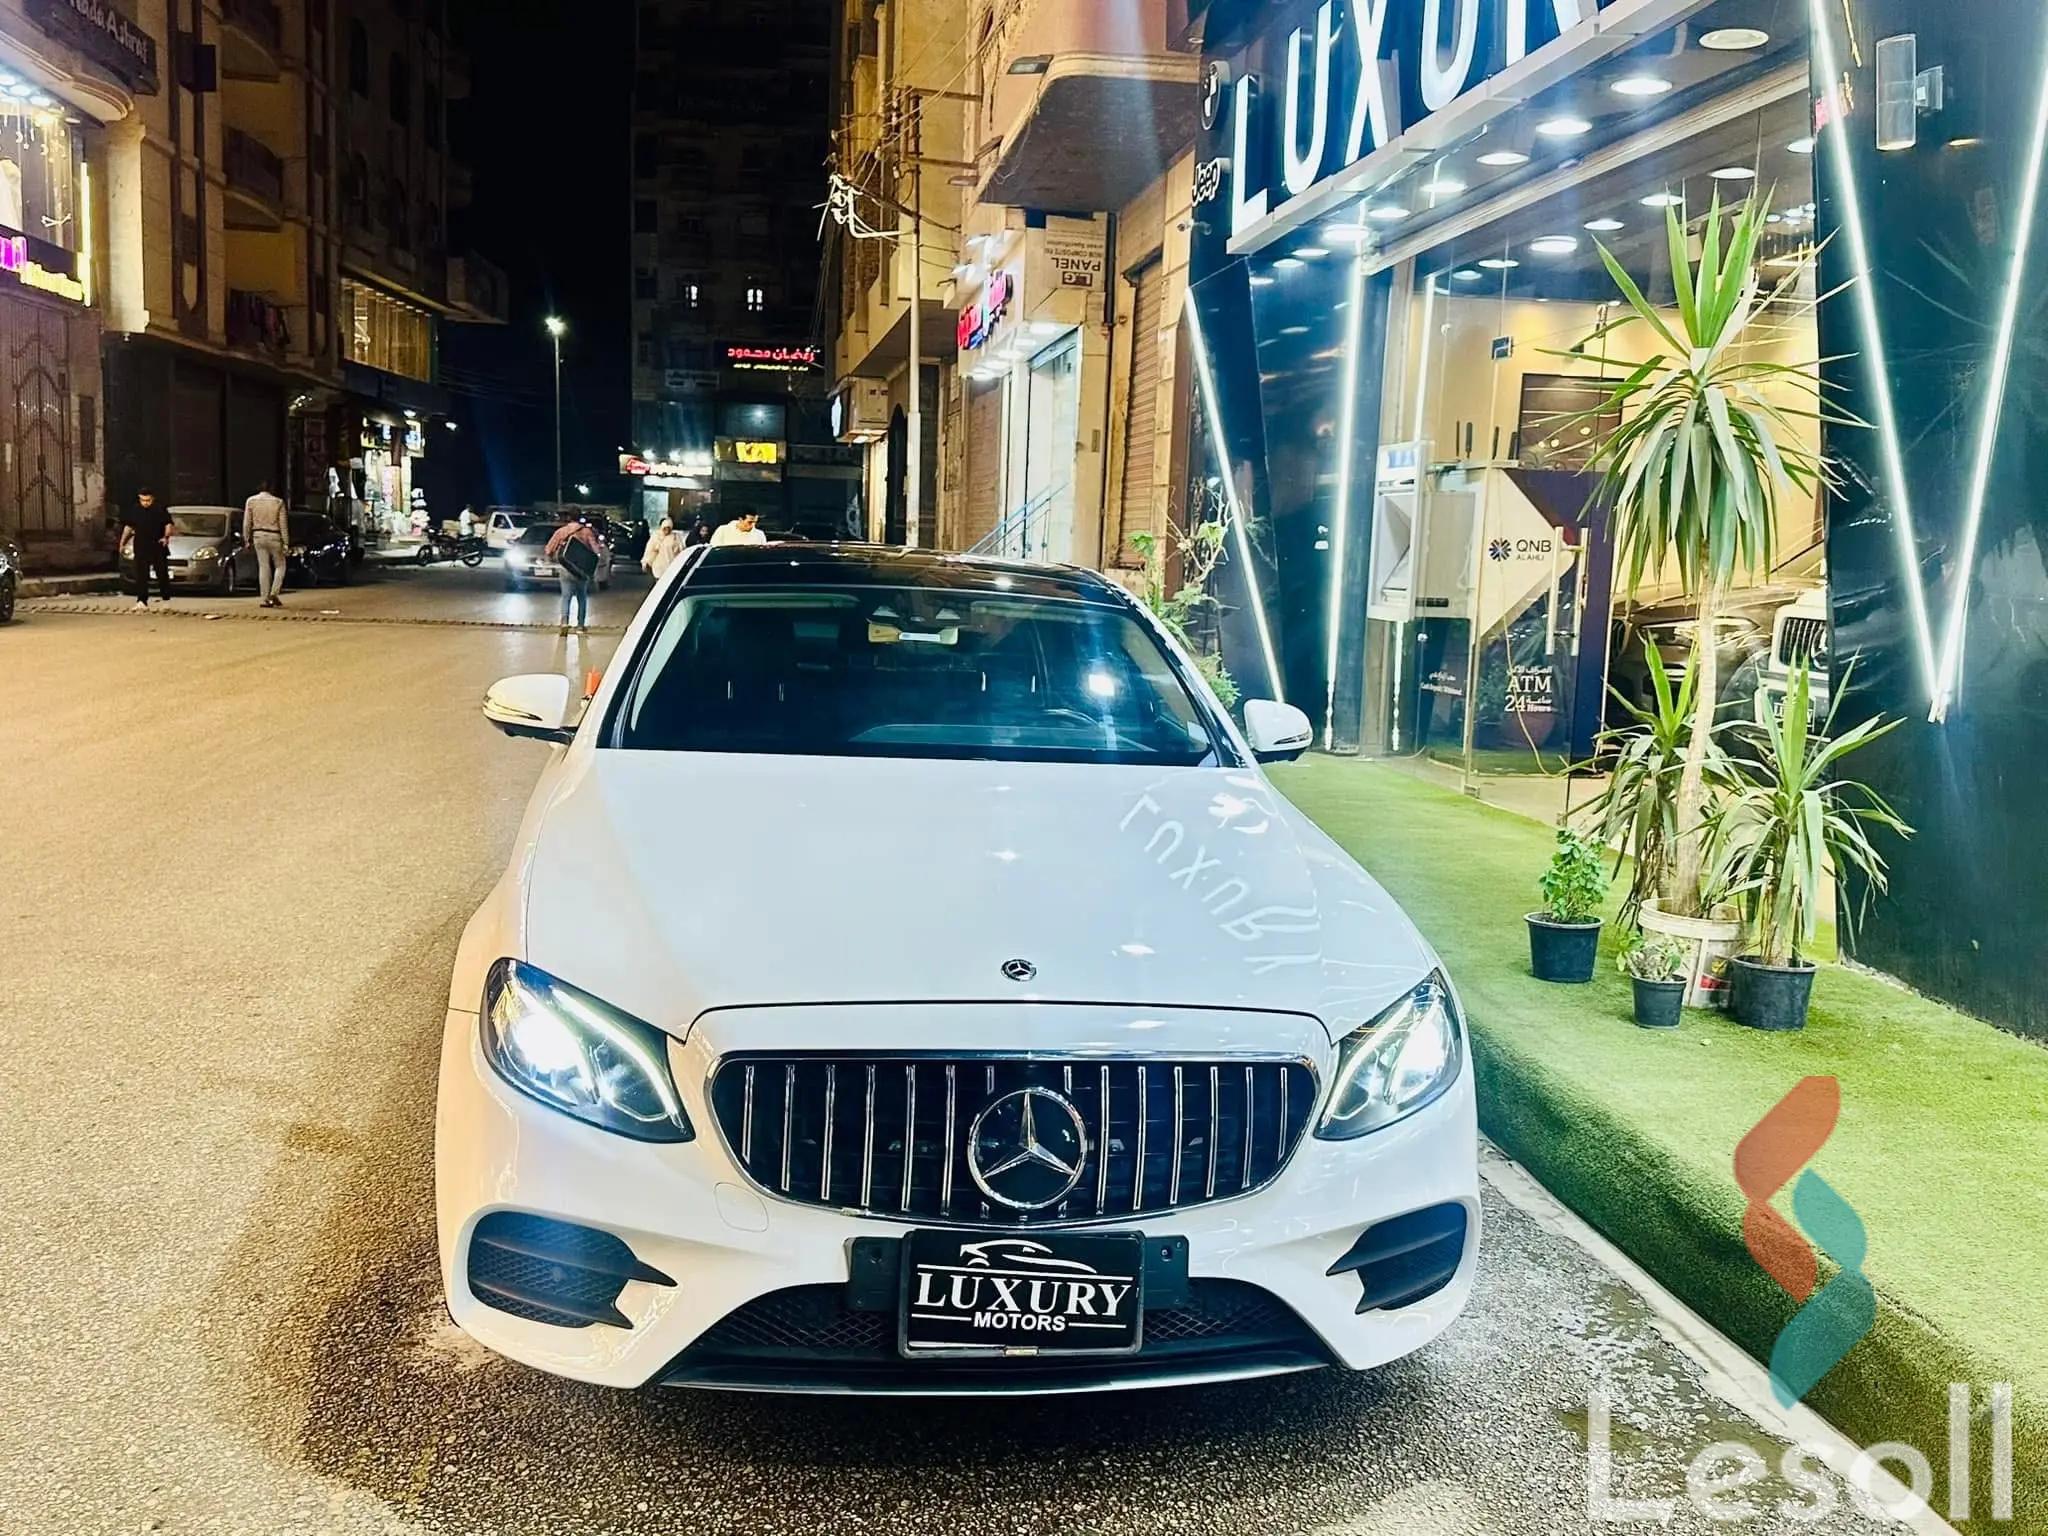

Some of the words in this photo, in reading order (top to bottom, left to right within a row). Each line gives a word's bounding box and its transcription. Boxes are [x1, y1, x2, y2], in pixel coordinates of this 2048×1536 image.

[1231, 0, 1583, 239] LUXU
[1191, 158, 1220, 207] Jeep
[1051, 257, 1101, 271] PANEL
[727, 348, 771, 358] محمود
[1516, 539, 1552, 552] QNB
[1505, 676, 1552, 692] ATM
[1504, 695, 1526, 712] 24
[914, 1272, 1132, 1316] LUXURY
[973, 1311, 1066, 1332] MOTORS
